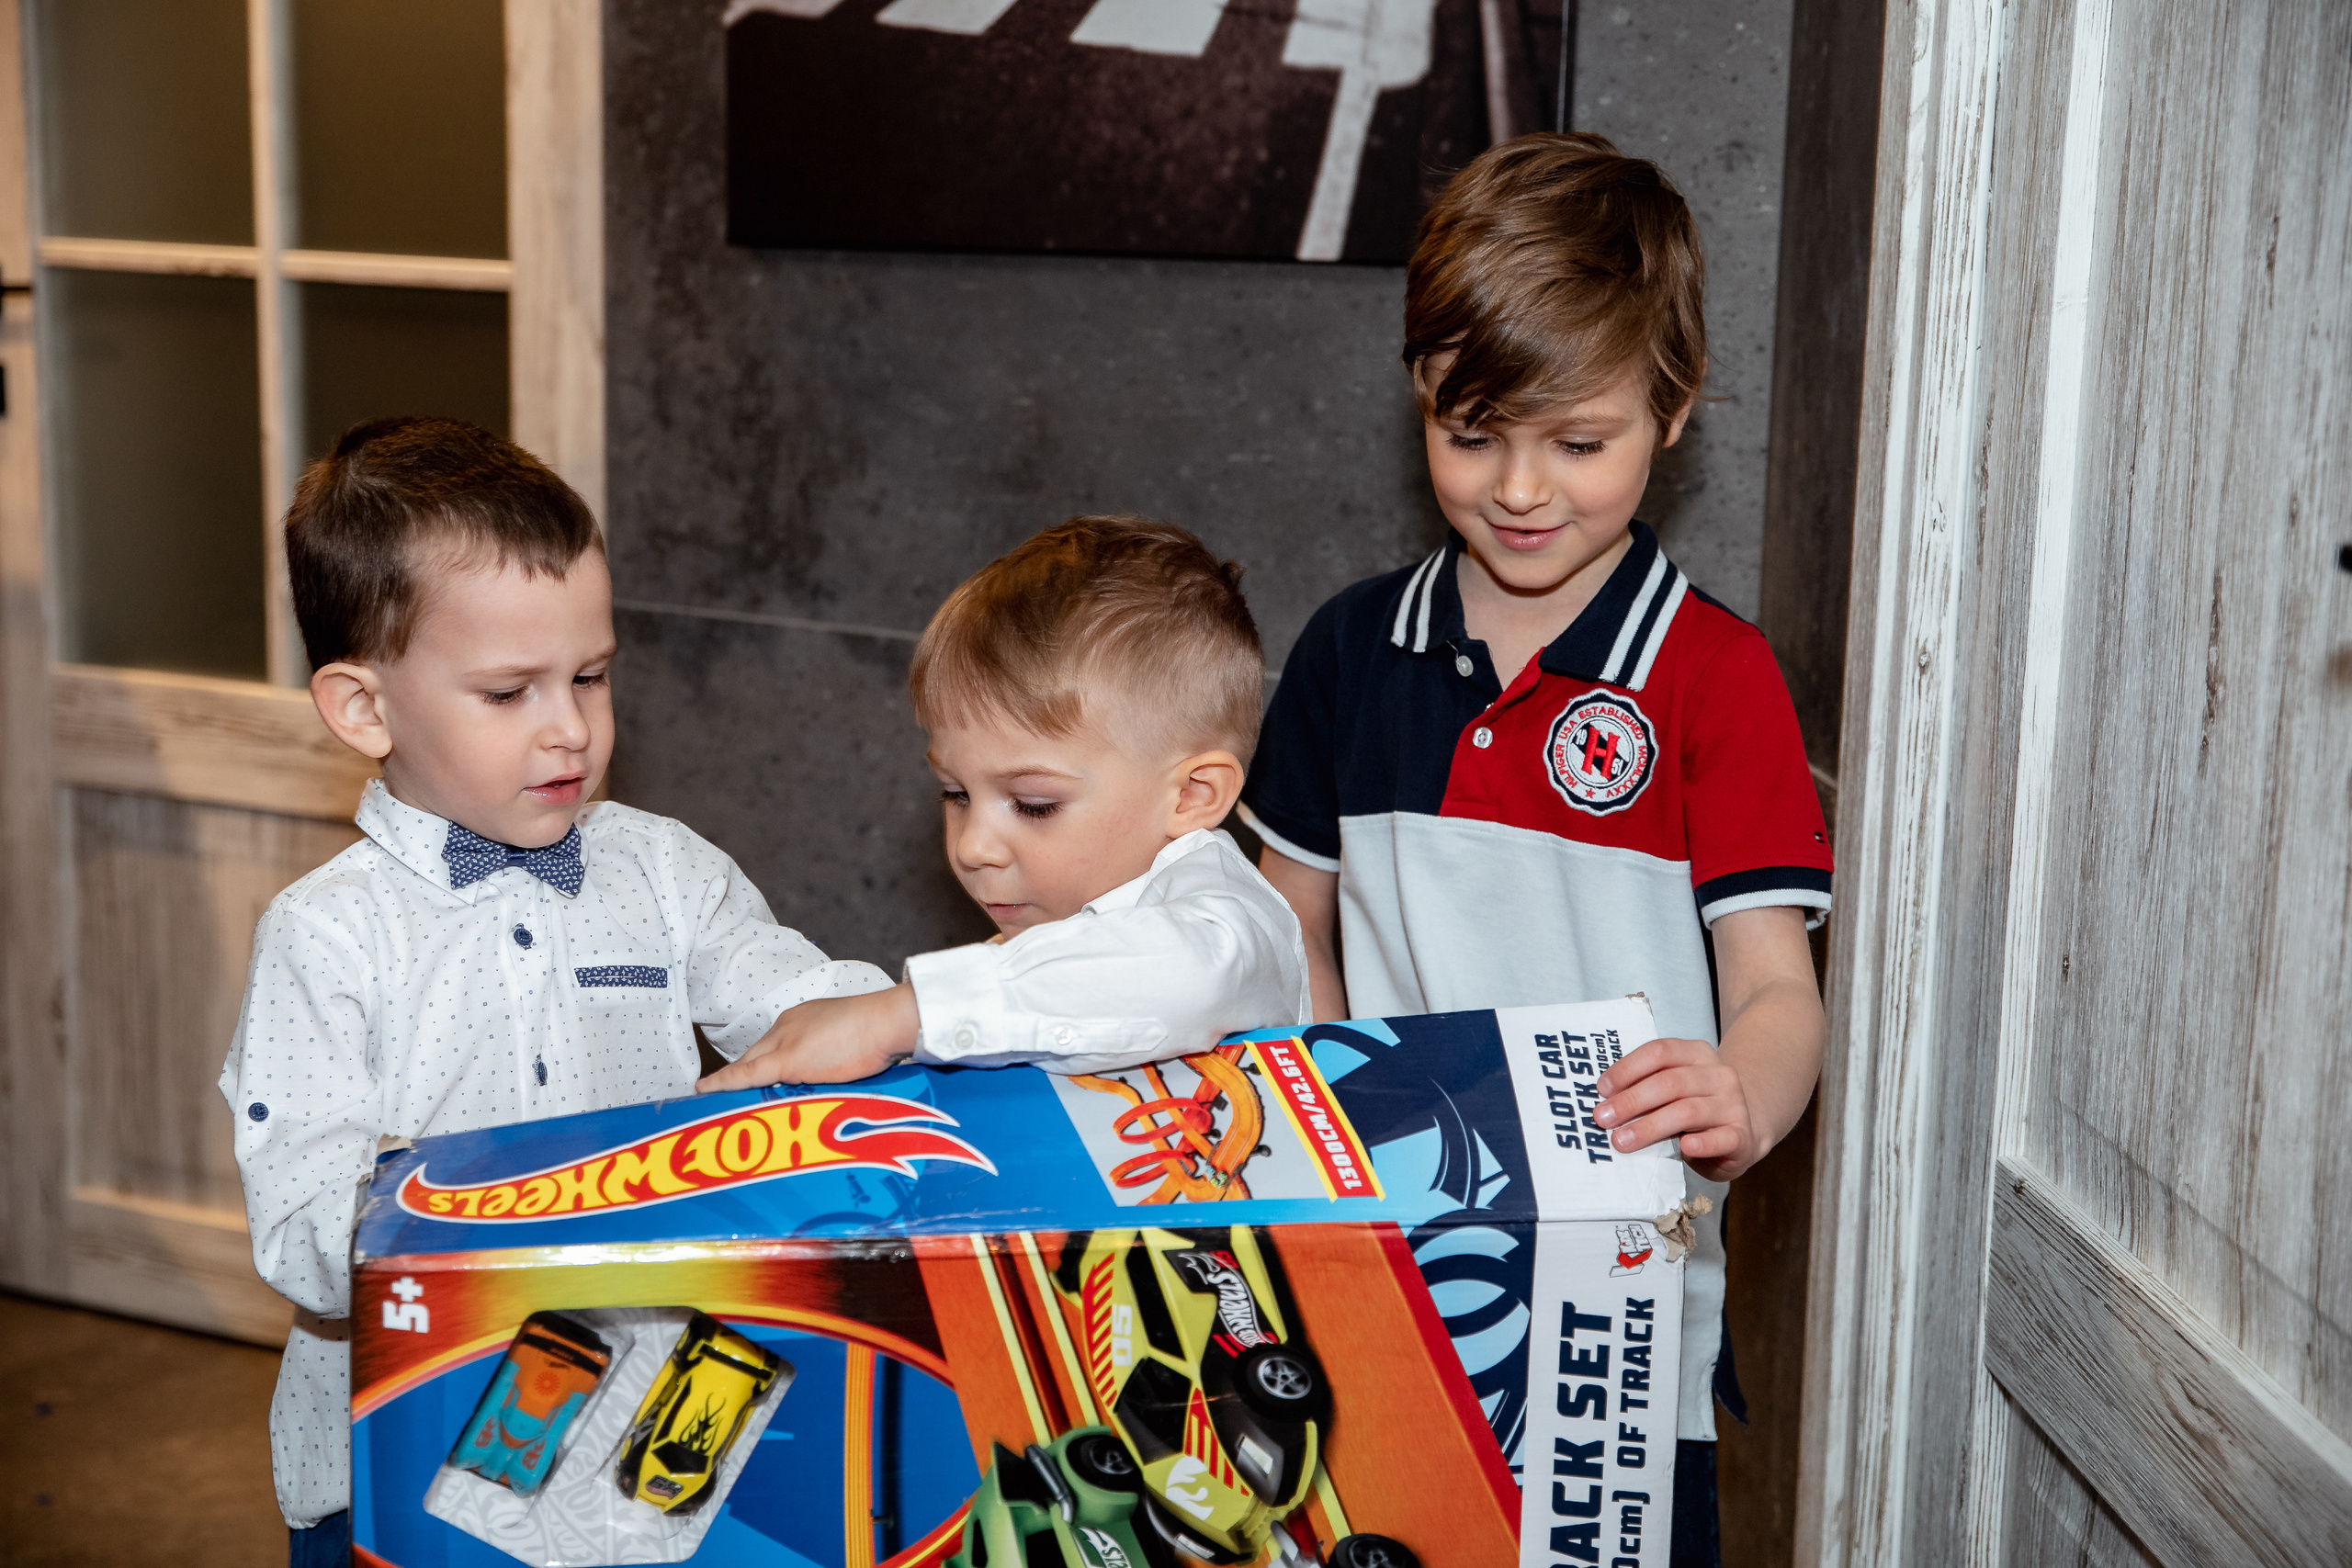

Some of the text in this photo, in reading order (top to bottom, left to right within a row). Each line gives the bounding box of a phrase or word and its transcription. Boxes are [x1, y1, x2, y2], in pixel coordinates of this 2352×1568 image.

[1559, 720, 1577, 740] USA
[1576, 728, 1588, 746] 19
[1577, 706, 1645, 740] ESTABLISHED
[1554, 744, 1578, 788] HILFIGER
[1581, 727, 1620, 782] H
[1561, 1030, 1595, 1077] SET
[1590, 1032, 1610, 1075] 00cm)
[1606, 1029, 1623, 1065] RACK
[1534, 1033, 1582, 1150] SLOT CAR
[682, 1102, 854, 1179] HOT
[1269, 1045, 1363, 1190] 1300CM/42.6FT
[382, 1276, 430, 1333] 5+
[1111, 1304, 1132, 1366] 05
[1620, 1297, 1655, 1413] TRACK
[1549, 1301, 1612, 1568] ACK SET
[1617, 1422, 1646, 1470] OF
